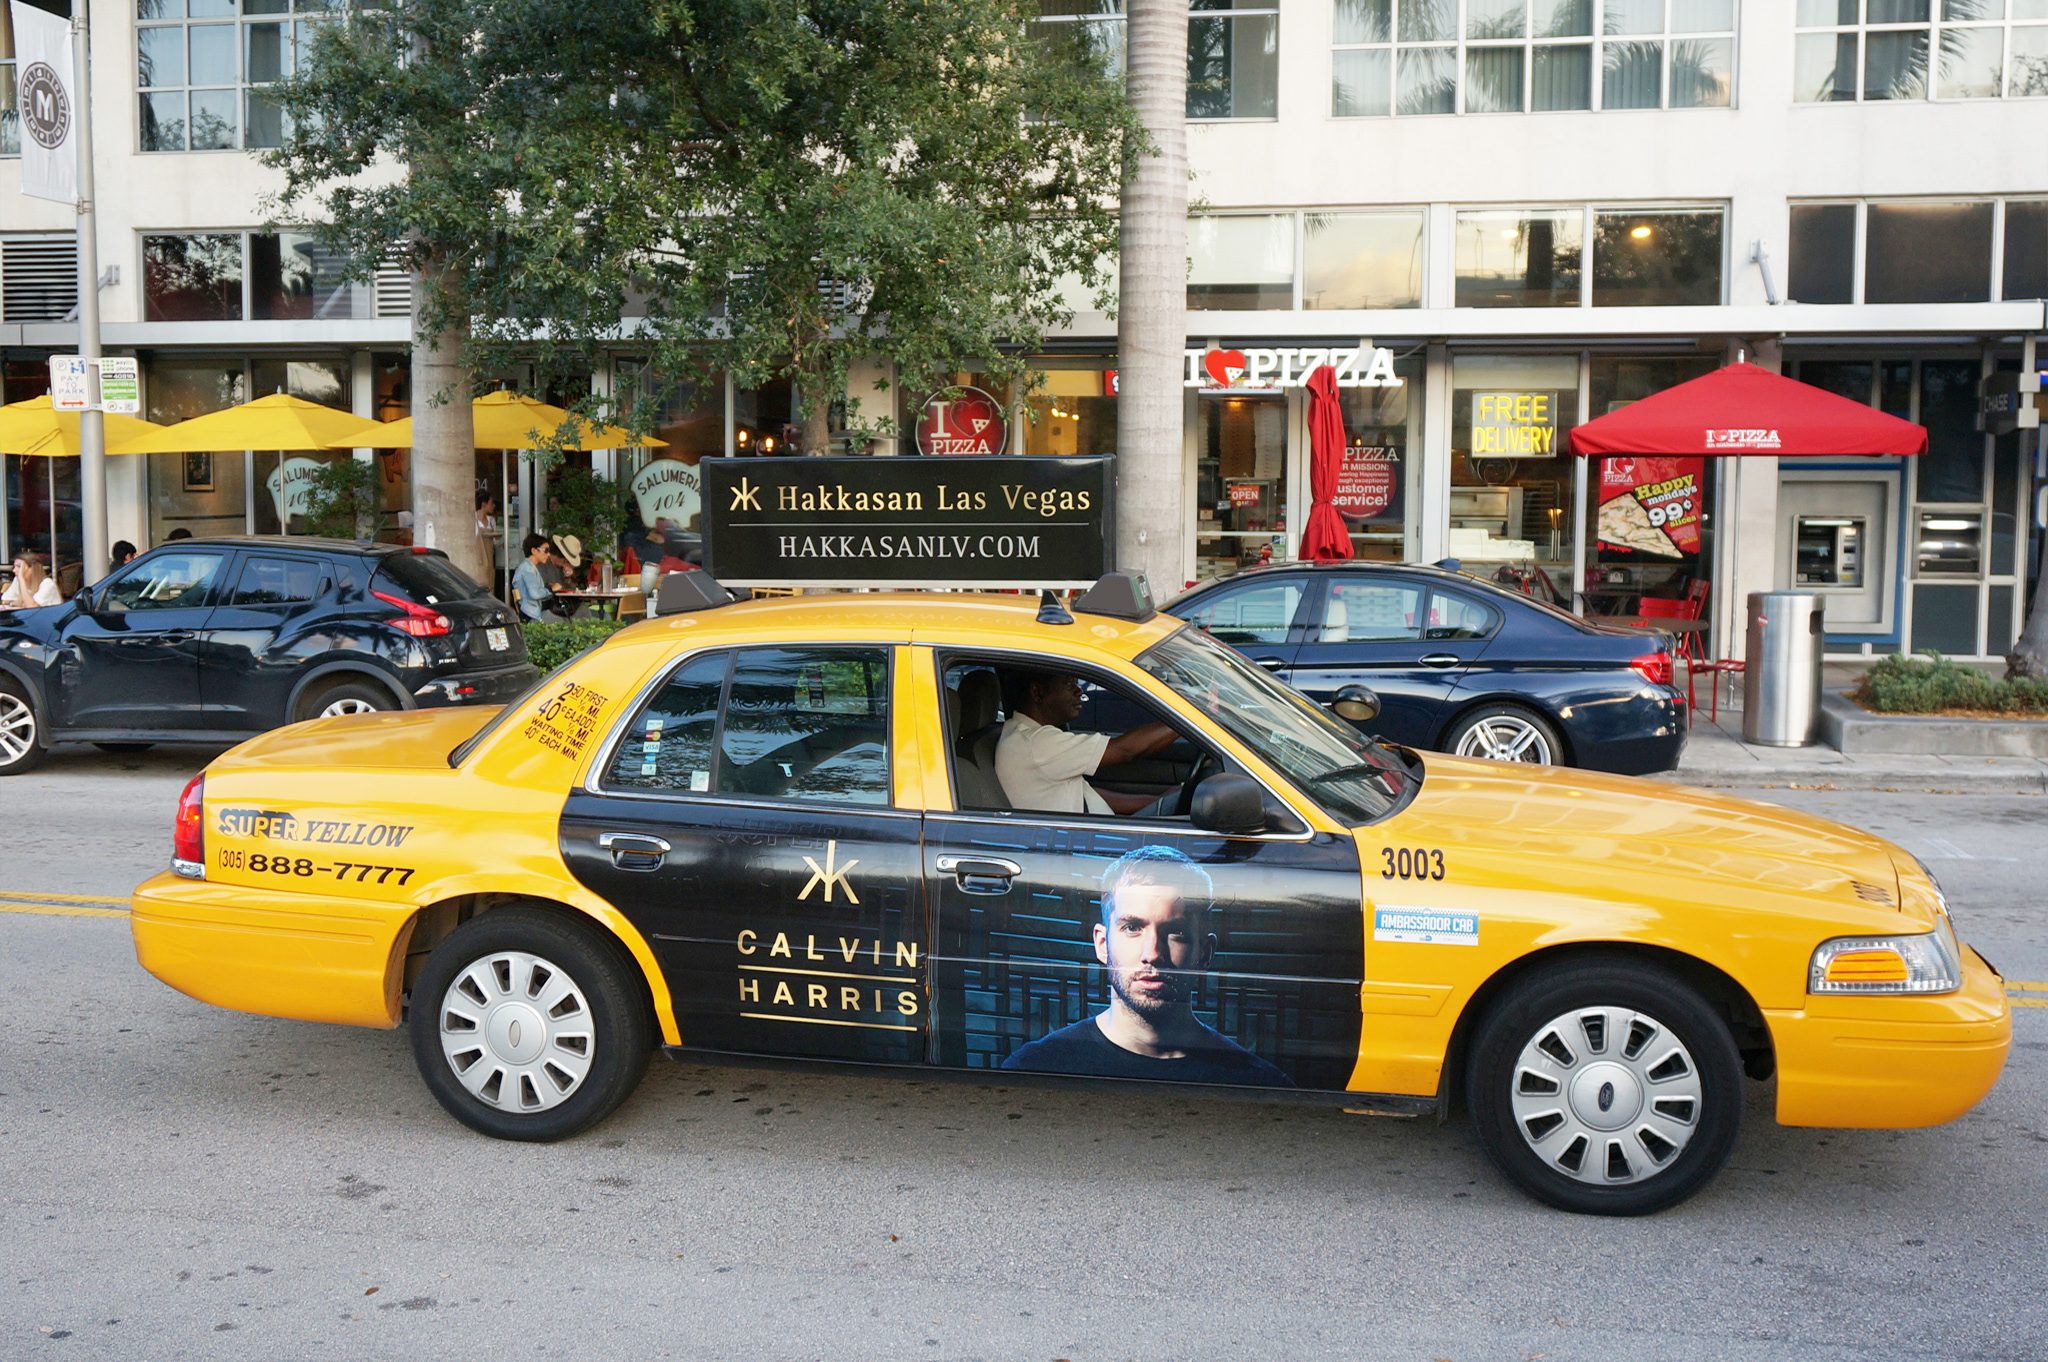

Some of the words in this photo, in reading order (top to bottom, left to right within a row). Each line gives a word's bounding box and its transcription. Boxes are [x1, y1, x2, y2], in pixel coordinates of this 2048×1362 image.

[35, 89, 55, 122] M
[1184, 348, 1206, 387] I
[1244, 347, 1403, 387] PIZZA
[1479, 395, 1549, 423] FREE
[1984, 393, 2008, 412] CHASE
[930, 401, 951, 438] I
[930, 439, 992, 455] PIZZA
[1474, 426, 1553, 453] DELIVERY
[1706, 429, 1715, 443] I
[1727, 429, 1782, 443] PIZZA
[1343, 447, 1400, 461] PIZZA
[1350, 463, 1389, 471] MISSION:
[1604, 474, 1634, 483] PIZZA
[1231, 490, 1259, 500] OPEN
[1635, 474, 1694, 500] Happy
[1647, 485, 1698, 506] mondays
[653, 490, 686, 512] 104
[777, 484, 923, 511] Hakkasan
[936, 484, 987, 511] Las
[1000, 483, 1091, 517] Vegas
[1331, 493, 1388, 506] service!
[1670, 515, 1697, 528] slices
[778, 535, 1041, 559] HAKKASANLV.COM
[584, 690, 608, 707] FIRST
[586, 705, 600, 719] MI.
[531, 717, 564, 739] WAITING
[565, 735, 585, 751] TIME
[575, 727, 589, 743] MI.
[538, 734, 561, 751] EACH
[561, 745, 578, 761] MIN.
[219, 808, 299, 841] SUPER
[303, 820, 414, 848] YELLOW
[219, 847, 246, 873] (305)
[249, 853, 415, 886] 888-7777
[1381, 847, 1446, 881] 3003
[1381, 913, 1452, 932] AMBASSADOR
[1452, 917, 1474, 934] CAB
[737, 929, 918, 968] CALVIN
[738, 978, 919, 1016] HARRIS
